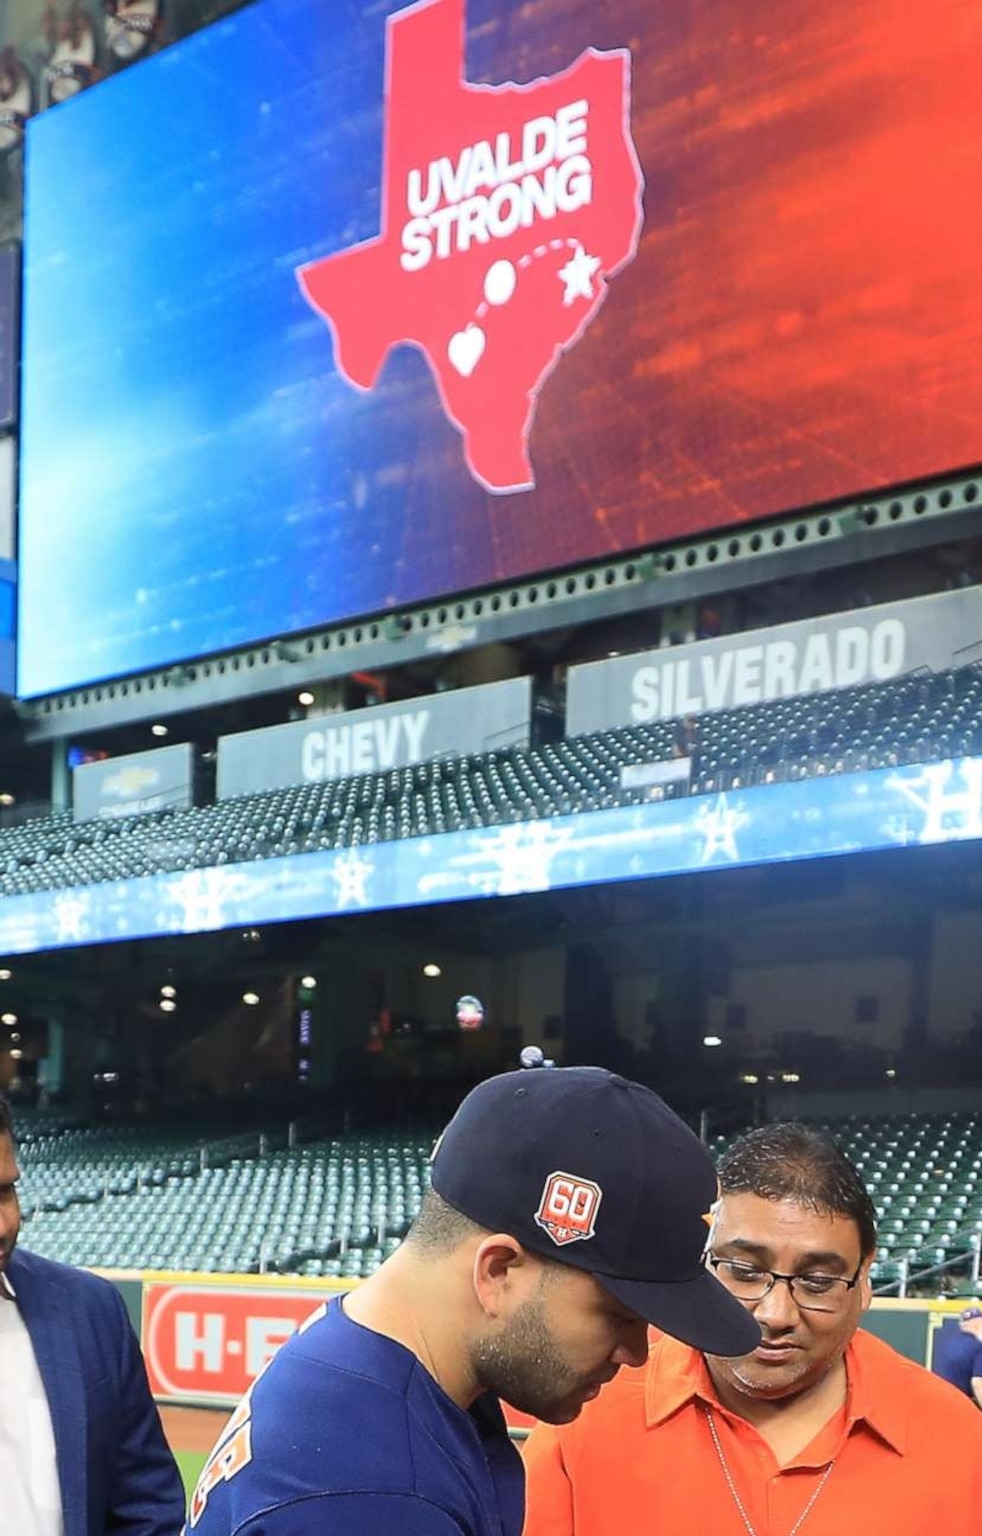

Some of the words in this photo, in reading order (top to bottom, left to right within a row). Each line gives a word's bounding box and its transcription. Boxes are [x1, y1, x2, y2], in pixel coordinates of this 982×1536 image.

[406, 98, 590, 216] UVALDE
[400, 155, 593, 272] STRONG
[630, 618, 906, 723] SILVERADO
[301, 709, 431, 781] CHEVY
[548, 1179, 595, 1222] 60
